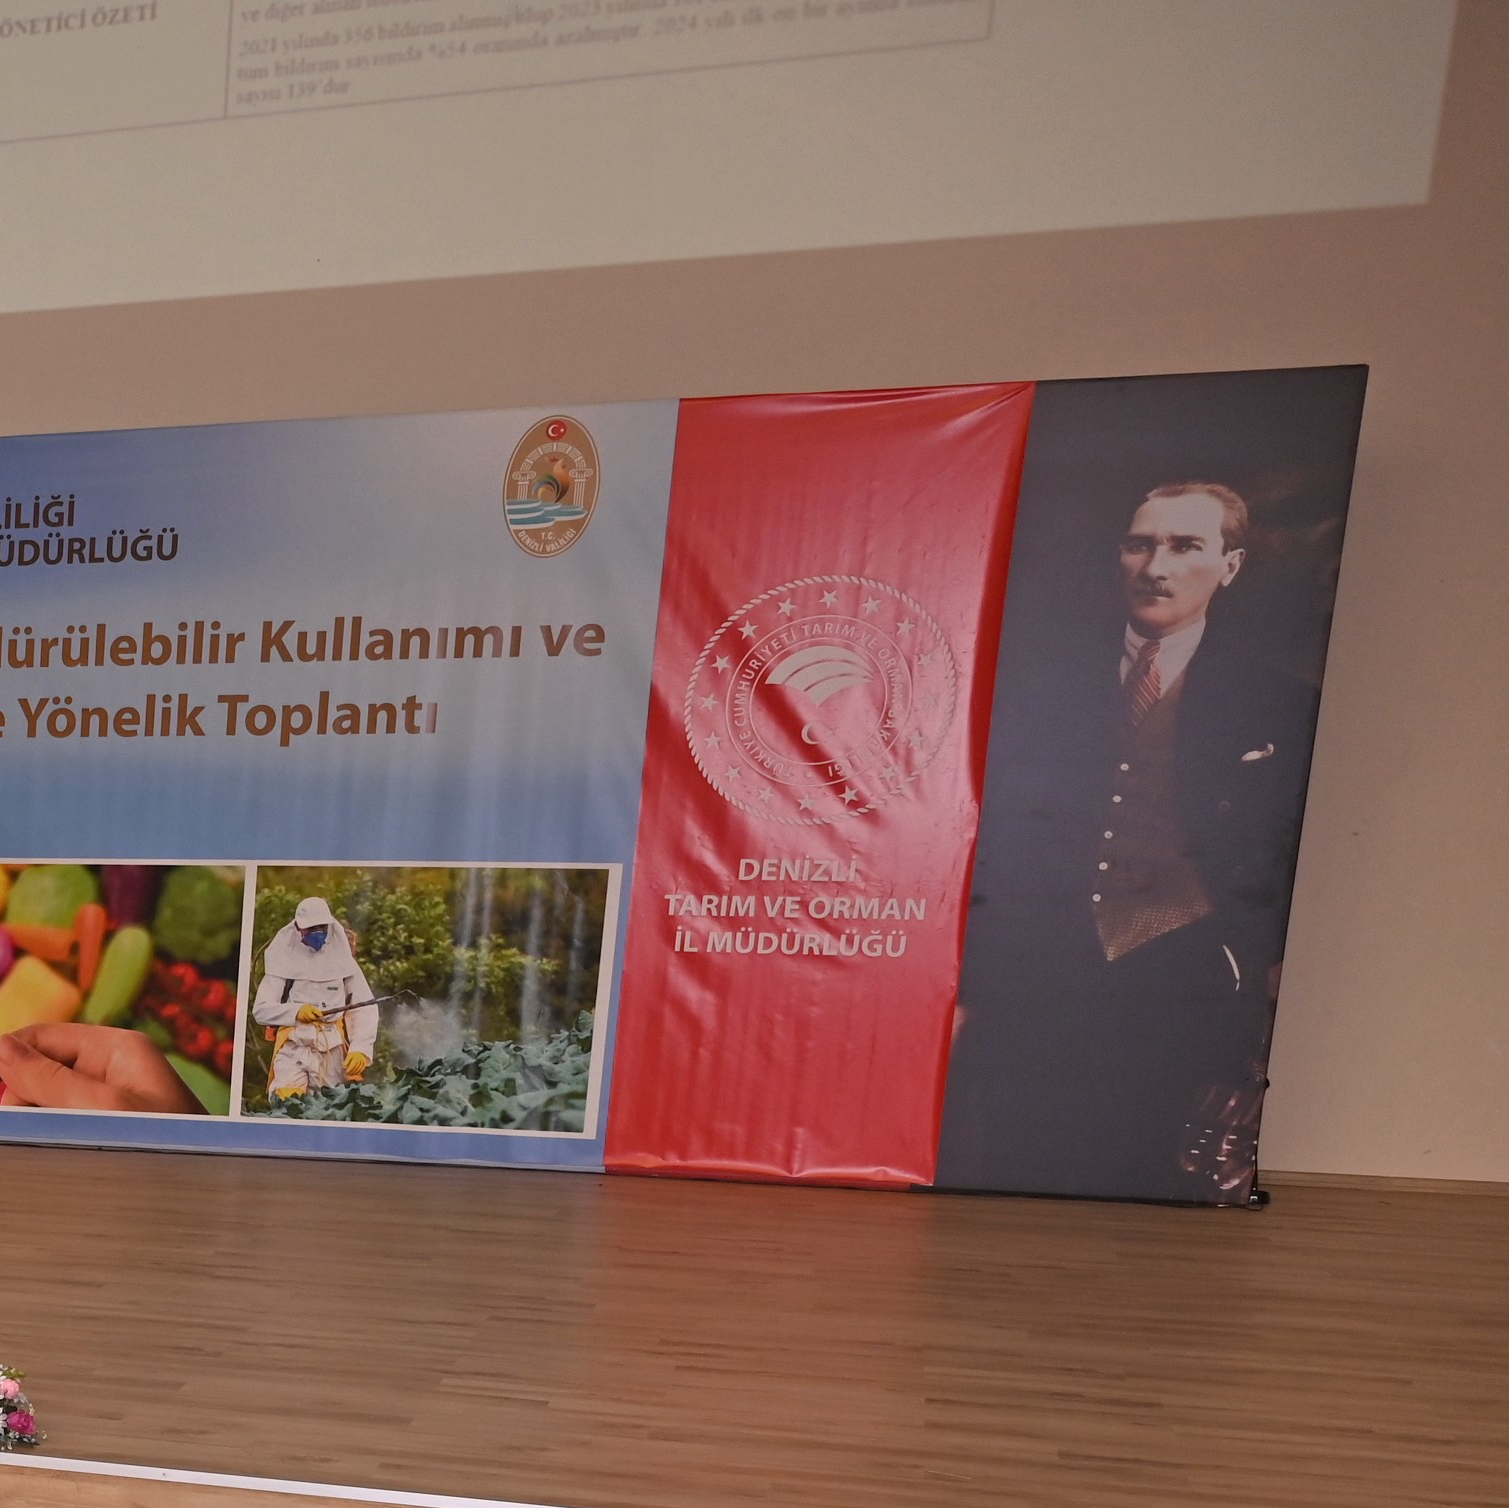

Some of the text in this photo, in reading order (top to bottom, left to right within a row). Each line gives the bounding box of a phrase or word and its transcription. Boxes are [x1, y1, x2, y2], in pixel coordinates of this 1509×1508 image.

[91, 0, 158, 27] ÖZETİ
[260, 616, 522, 663] Kullanımı
[539, 622, 607, 657] ve
[801, 622, 856, 638] TARIM
[858, 632, 879, 649] VE
[733, 627, 797, 727] CUMHURİYETİ
[17, 693, 207, 739] Yönelik
[217, 690, 439, 748] Toplantı
[740, 731, 794, 777] TÜRKİYE
[738, 855, 859, 882] DENİZLİ
[664, 894, 927, 920] TARIM VE ORMAN
[674, 925, 907, 958] İL MÜDÜRLÜĞÜ
